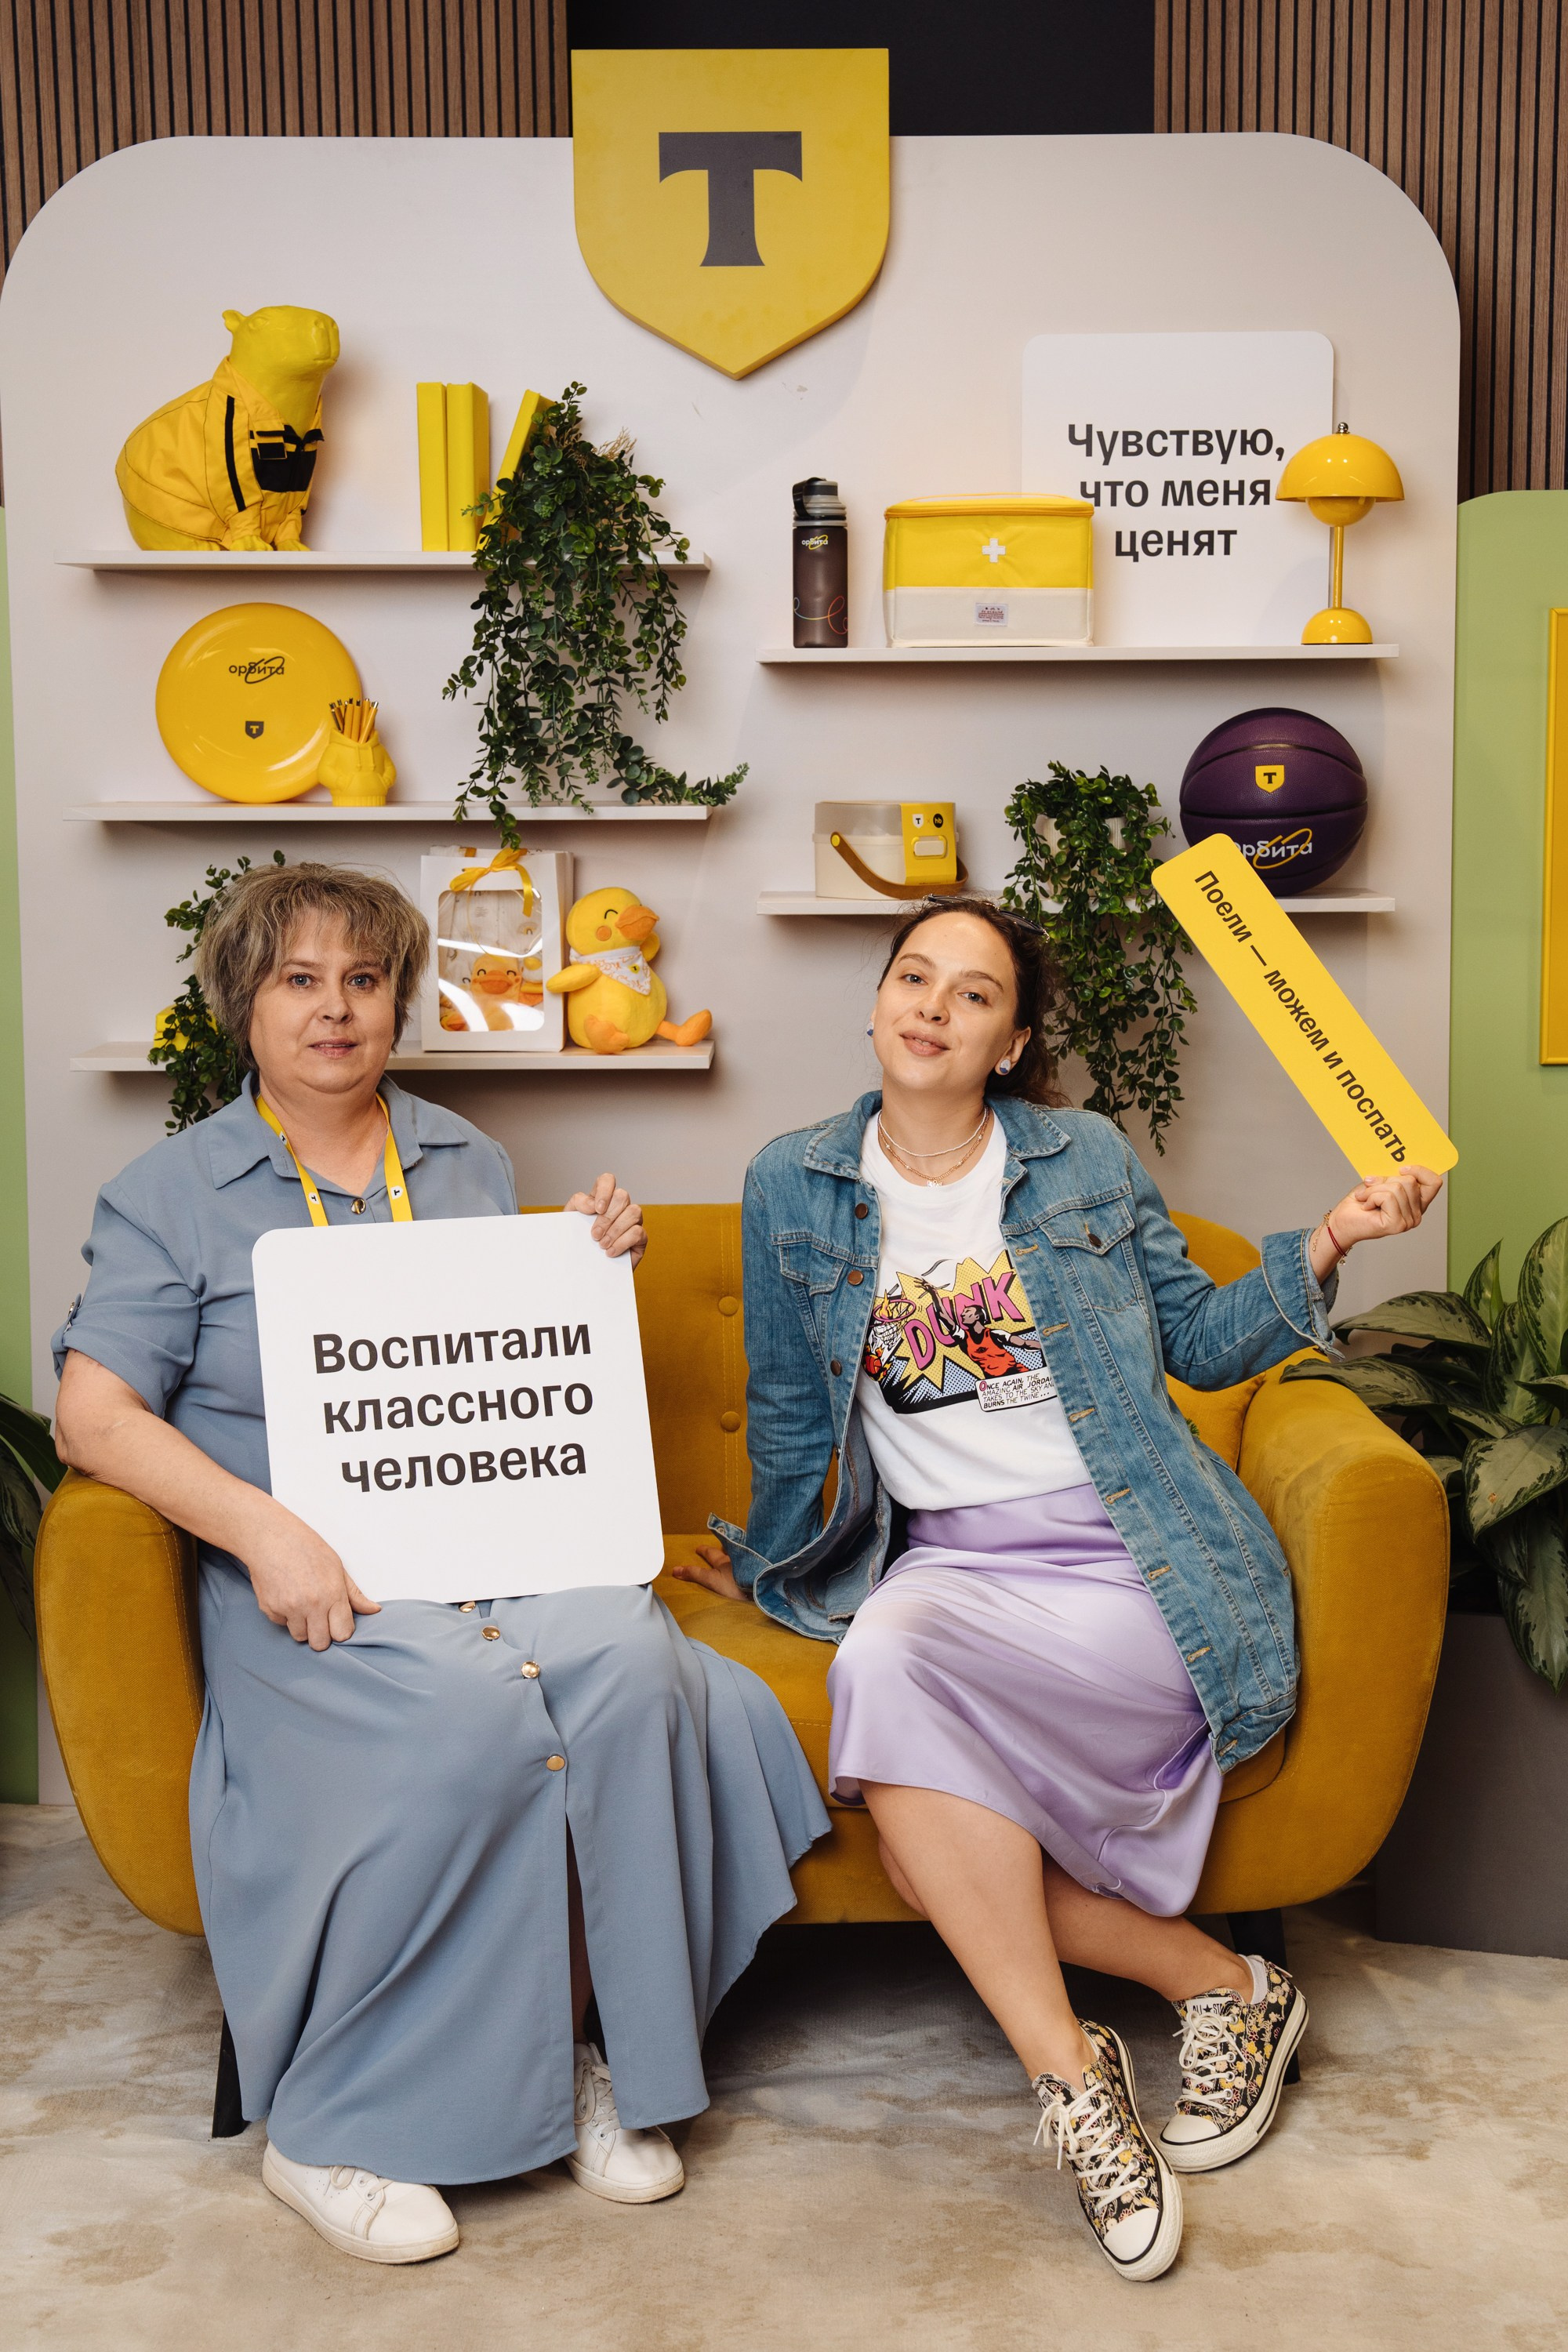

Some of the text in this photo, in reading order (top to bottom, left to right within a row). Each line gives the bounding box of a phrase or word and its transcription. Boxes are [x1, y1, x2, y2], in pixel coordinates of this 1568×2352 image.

[659, 131, 803, 267] T
[1068, 423, 1286, 466] Чувствую,
[1080, 479, 1271, 507] что меня
[801, 537, 829, 546] орбита
[1115, 529, 1238, 563] ценят
[228, 662, 285, 677] орбита
[250, 724, 260, 735] T
[1263, 771, 1277, 785] T
[1194, 870, 1253, 944] Поели
[1263, 969, 1330, 1052] можем
[1323, 1051, 1344, 1071] и
[1336, 1069, 1406, 1163] поспать
[903, 1271, 1027, 1371] DUNK
[314, 1323, 592, 1374] Воспитали
[979, 1380, 1000, 1392] ONCE
[1026, 1373, 1040, 1381] THE
[982, 1387, 1011, 1397] AMAZING
[1012, 1383, 1023, 1392] AIR
[983, 1393, 1003, 1403] TAKES
[1016, 1389, 1028, 1398] THE
[1030, 1385, 1043, 1394] SKY
[323, 1382, 593, 1434] классного
[983, 1399, 1005, 1410] BURNS
[341, 1443, 587, 1493] человека
